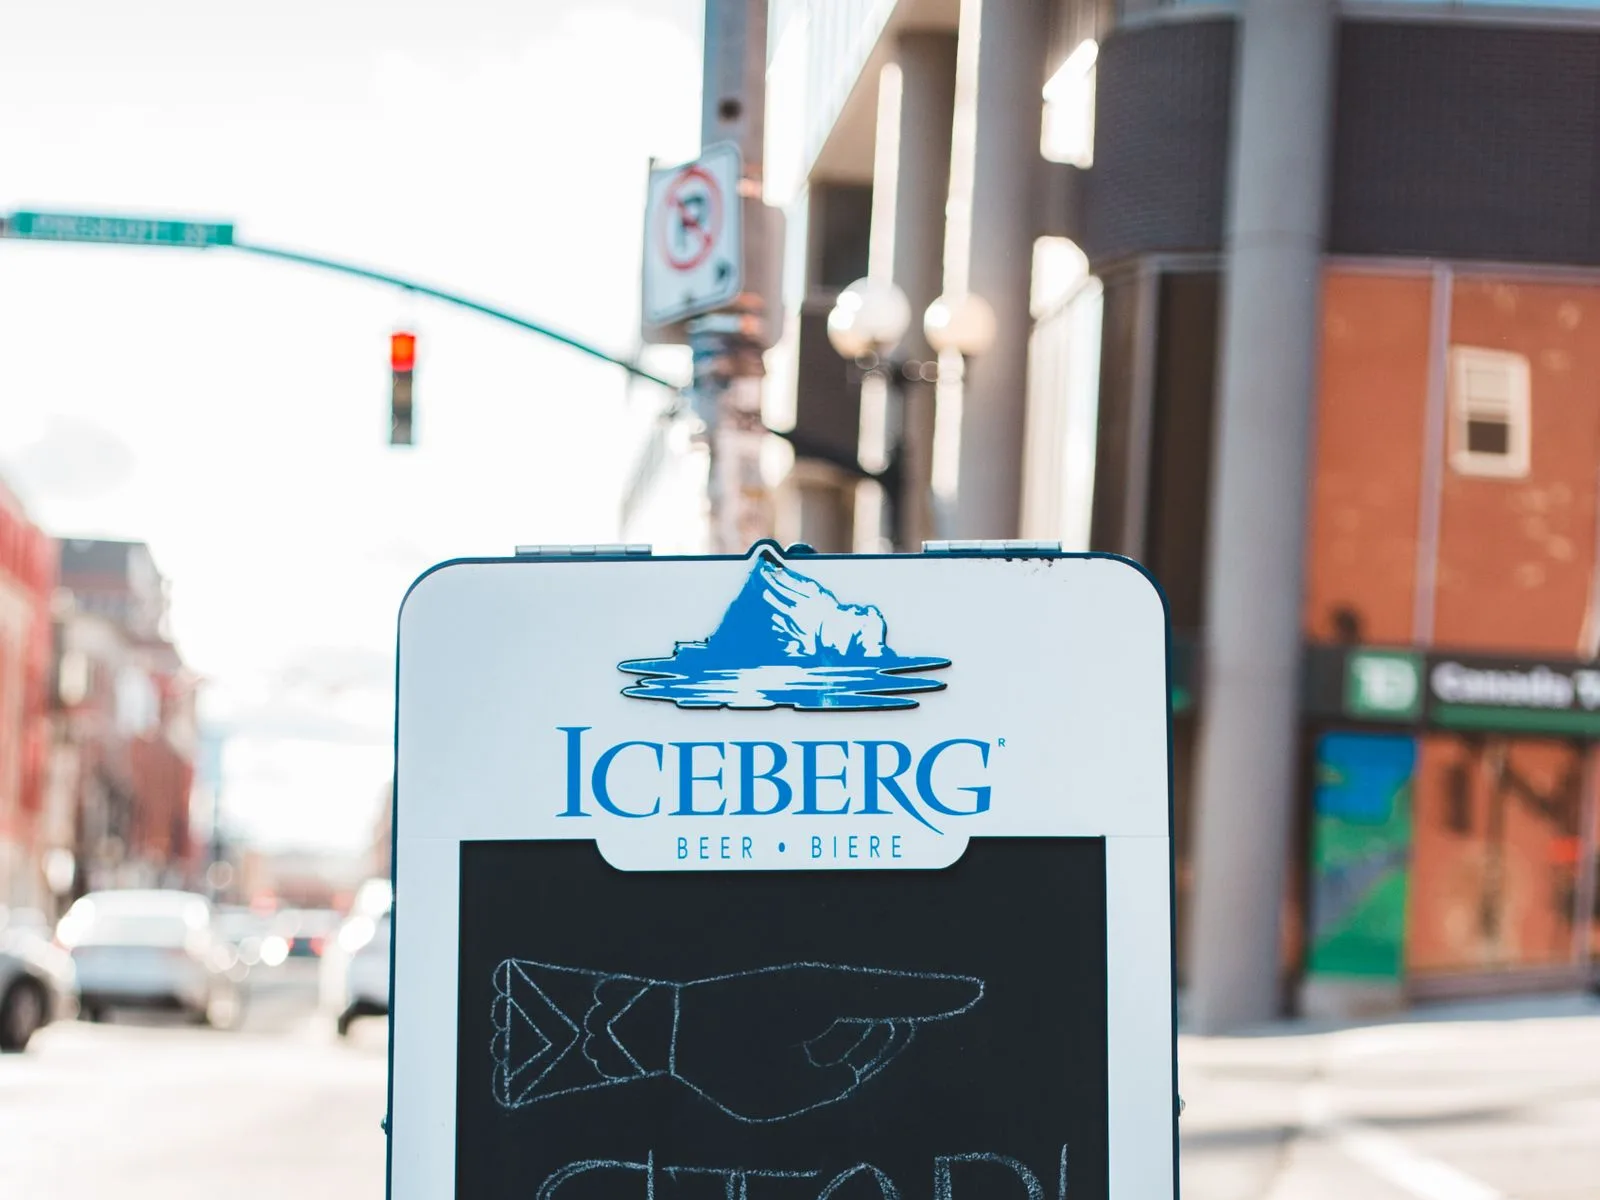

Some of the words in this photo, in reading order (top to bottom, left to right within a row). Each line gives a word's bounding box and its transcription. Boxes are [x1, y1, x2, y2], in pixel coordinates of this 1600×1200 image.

[555, 726, 992, 836] ICEBERG
[677, 836, 754, 860] BEER
[811, 835, 903, 859] BIERE
